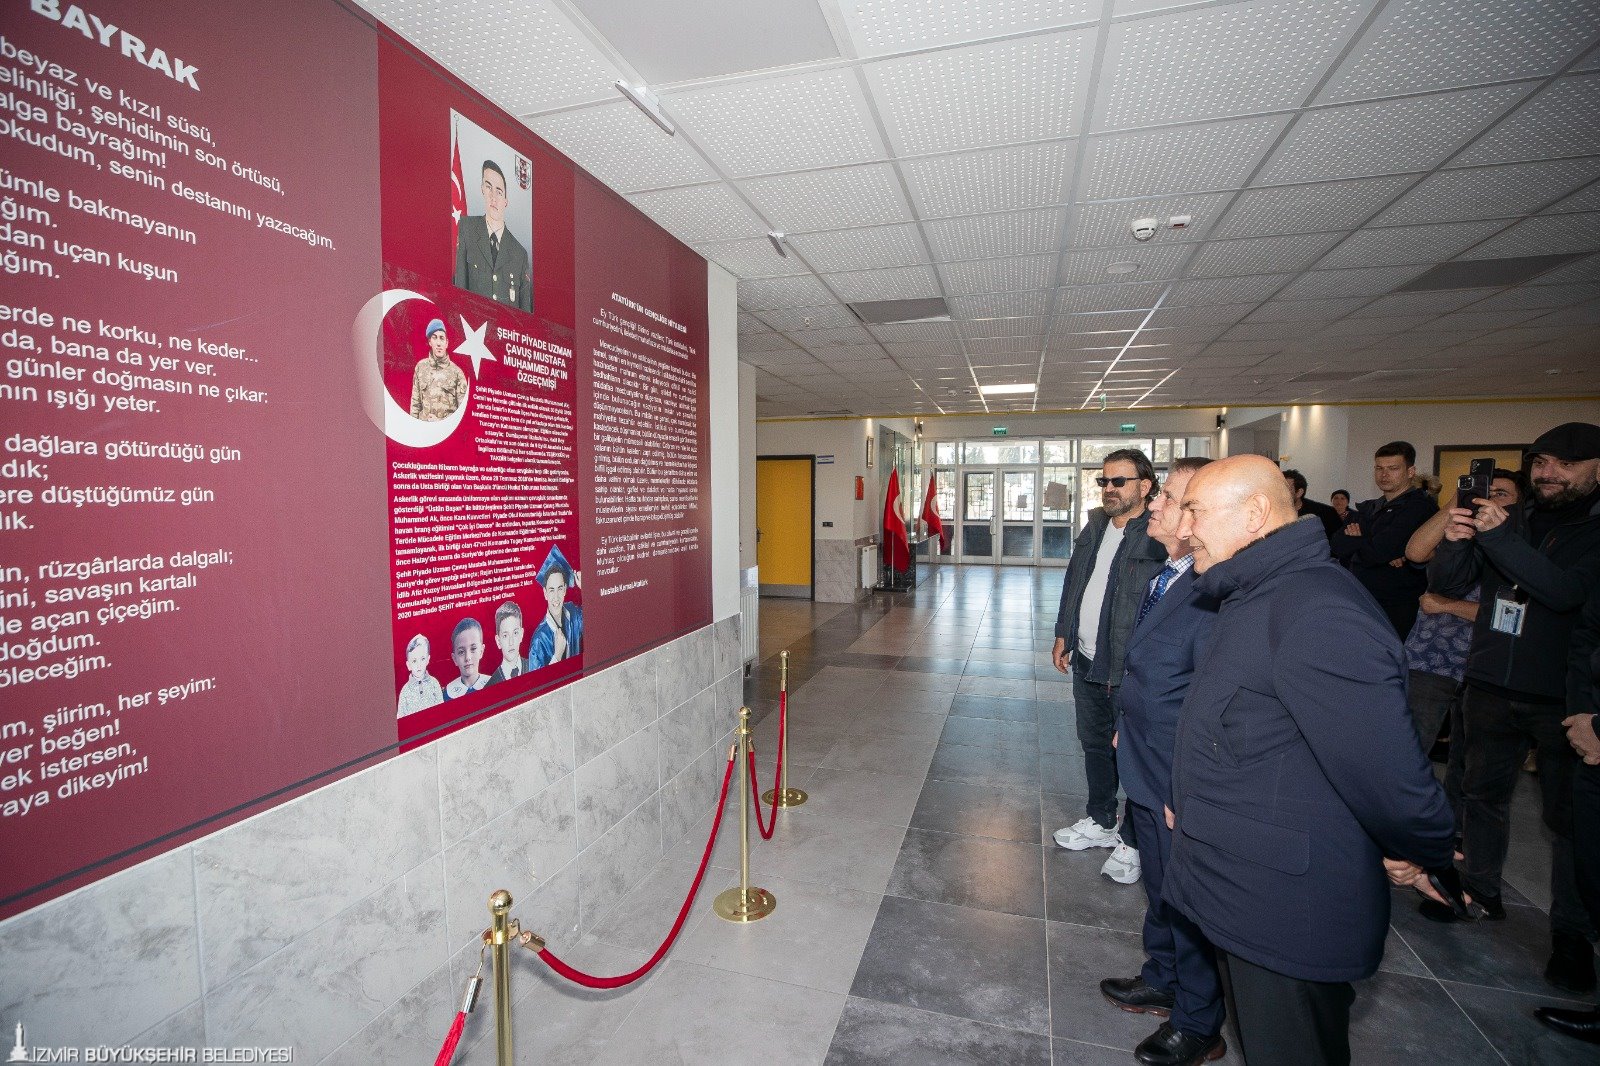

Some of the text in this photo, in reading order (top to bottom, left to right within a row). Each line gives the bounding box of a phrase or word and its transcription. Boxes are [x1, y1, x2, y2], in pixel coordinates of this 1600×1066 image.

[30, 0, 200, 92] BAYRAK
[0, 37, 216, 148] beyaz ve kızıl süsü,
[0, 67, 285, 196] elinliği, şehidimin son örtüsü,
[57, 112, 166, 168] bayrağım!
[0, 118, 336, 250] okudum, senin destanını yazacağım.
[1, 195, 57, 228] ğım.
[69, 190, 196, 244] bakmayanın
[0, 224, 178, 283] dan uçan kuşun
[0, 304, 258, 362] erde ne korku, ne keder...
[497, 327, 572, 358] ŞEHİT PİYADE UZMAN
[2, 329, 216, 376] da, bana da yer ver.
[504, 355, 567, 380] MUHAMMED AK'IN
[506, 343, 566, 368] ÇAVUŞ MUSTAFA
[7, 358, 268, 403] günler doğmasın ne çıkar:
[517, 370, 556, 391] ÖZGEÇMİŞİ
[47, 390, 96, 410] ışığı
[104, 395, 160, 413] yeter.
[5, 433, 240, 464] dağlara götürdüğü gün
[0, 460, 48, 481] dık;
[42, 486, 175, 508] düştüğümüz
[181, 487, 214, 505] gün
[39, 553, 163, 580] rüzgârlarda
[170, 549, 233, 568] dalgalı;
[45, 582, 132, 603] savaşın
[140, 573, 196, 594] kartalı
[31, 610, 90, 633] açan
[97, 598, 180, 625] çiçeğim.
[0, 633, 100, 662] doğdum.
[0, 655, 111, 688] öleceğim.
[0, 676, 216, 740] m, şiirim, her şeyim:
[41, 719, 120, 754] beğen!
[40, 742, 136, 780] istersen,
[57, 756, 148, 799] dikeyim!
